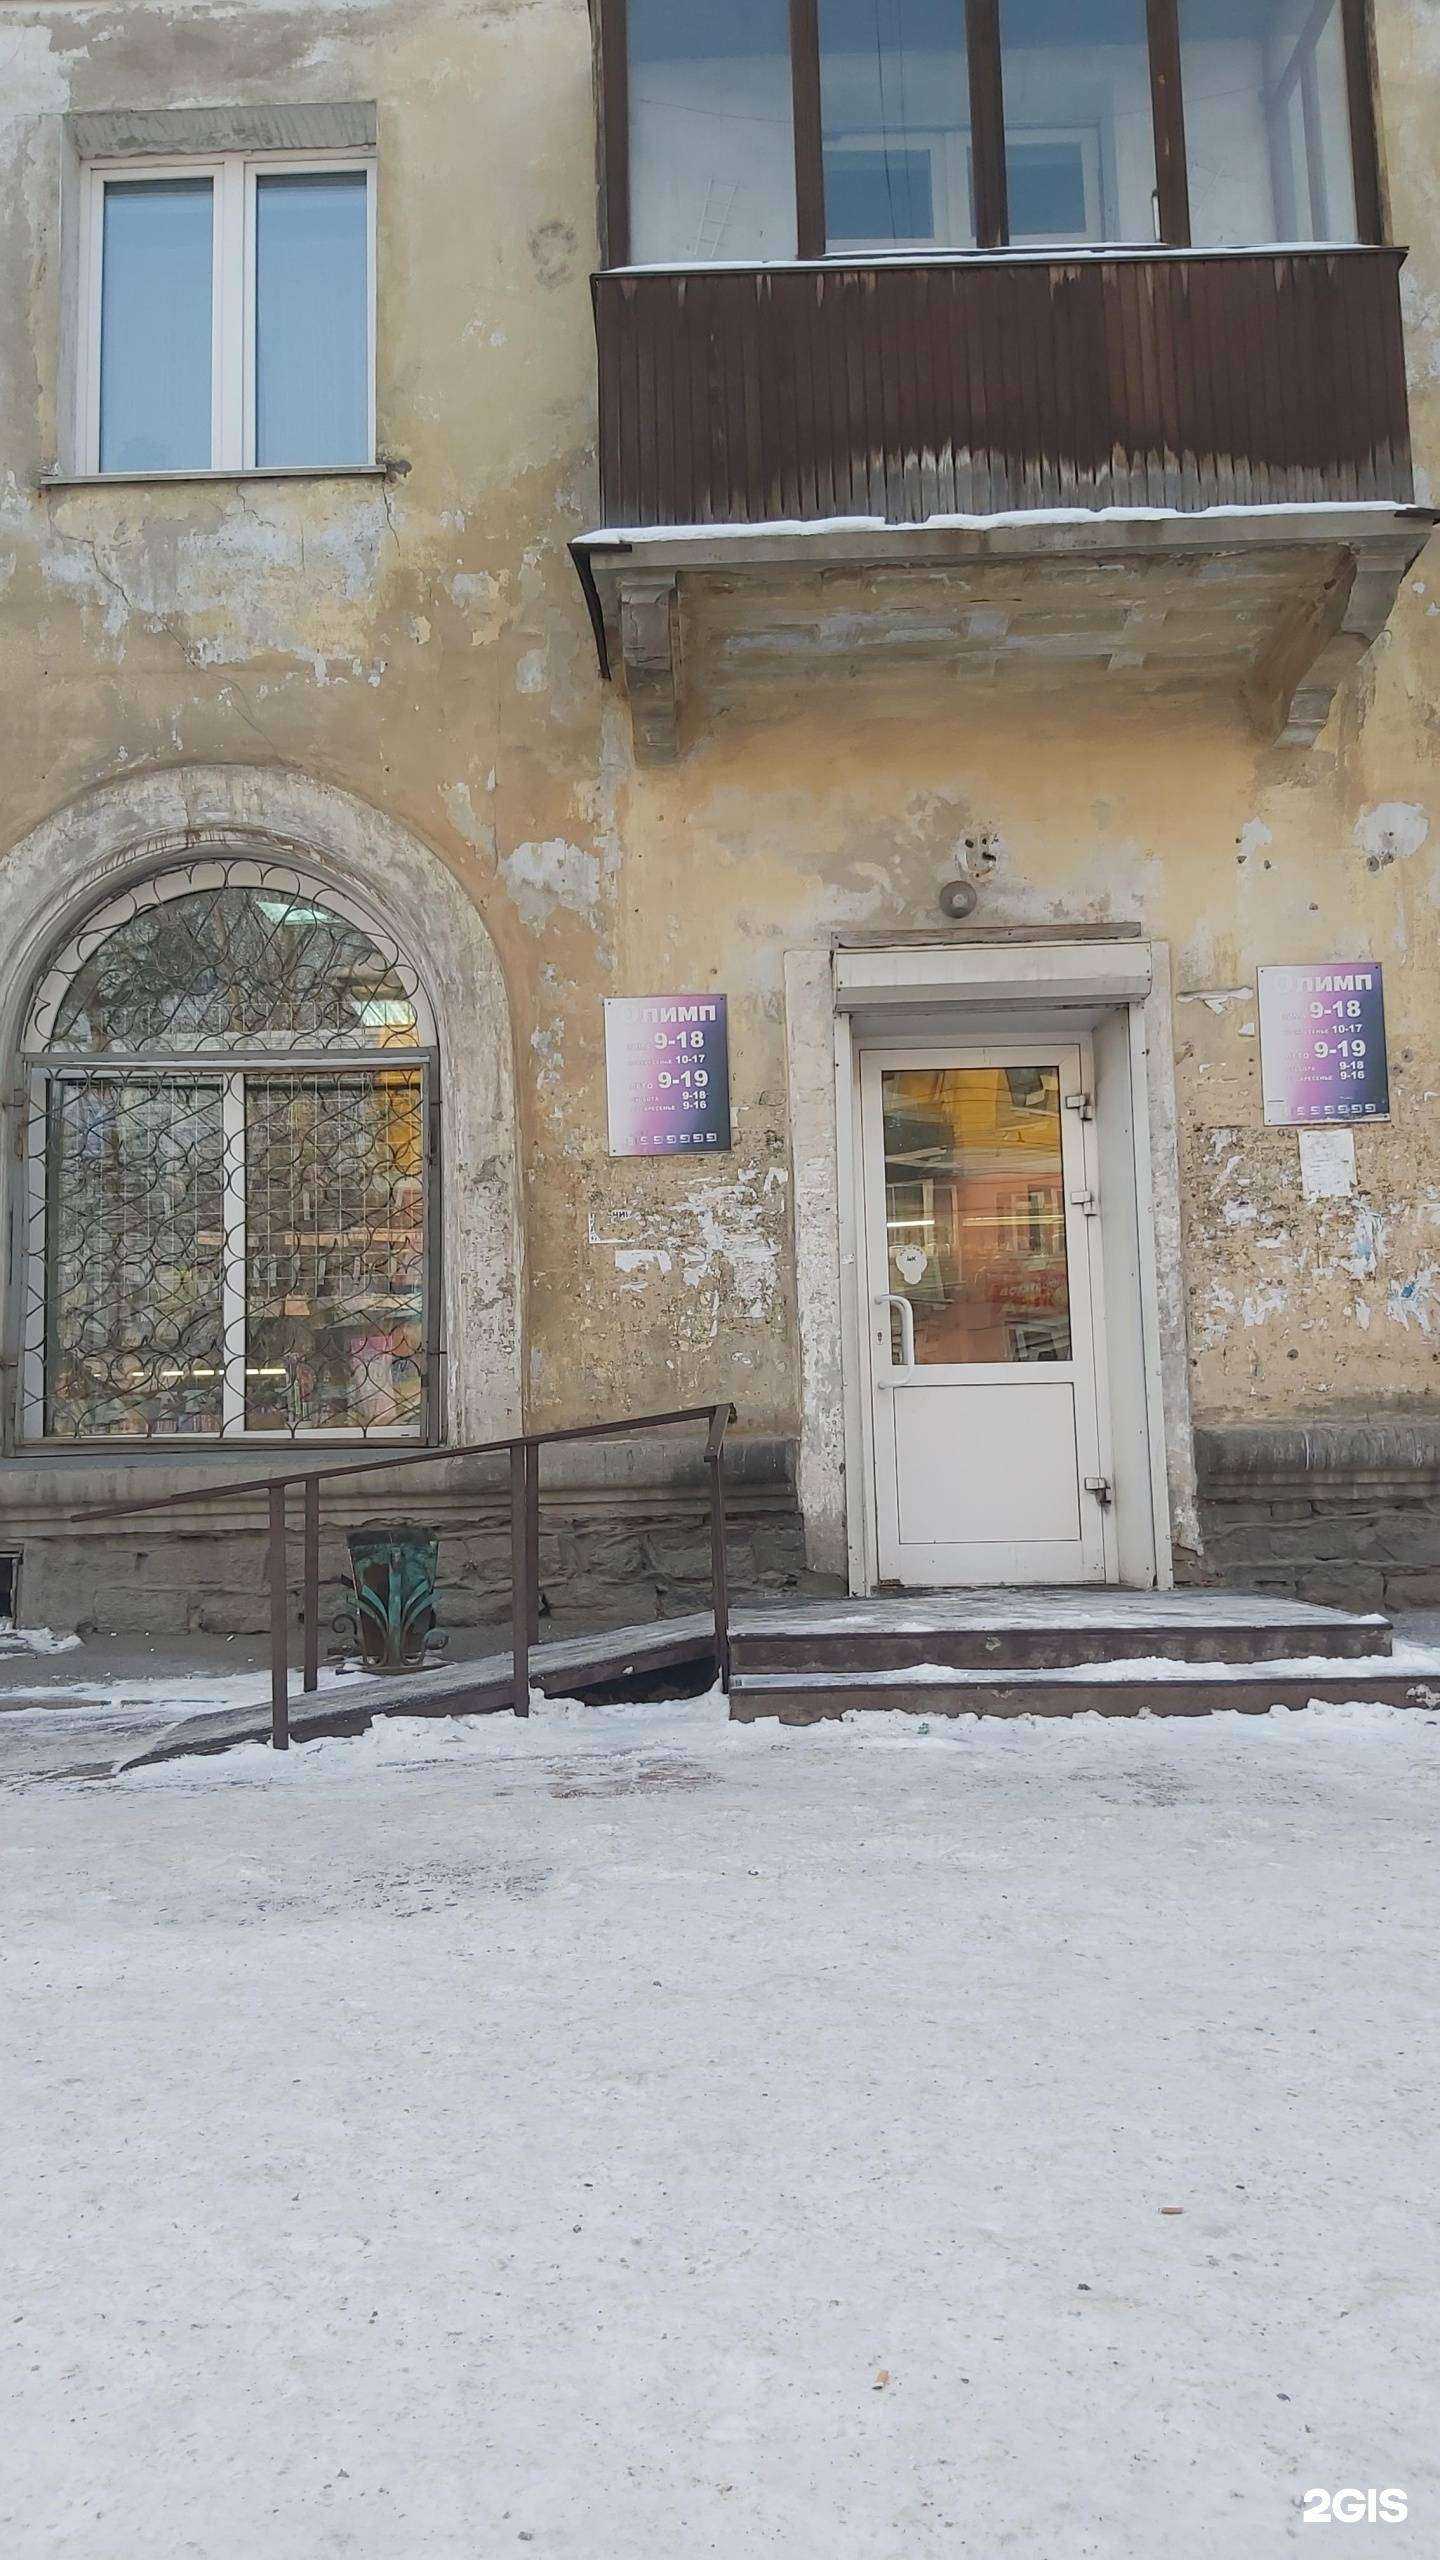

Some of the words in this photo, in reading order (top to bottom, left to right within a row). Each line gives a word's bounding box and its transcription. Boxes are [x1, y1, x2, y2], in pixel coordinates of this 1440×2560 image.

[1274, 974, 1372, 993] ОЛИМП
[624, 1005, 716, 1023] ОЛИМП
[1310, 999, 1361, 1019] 9-18
[1332, 1023, 1363, 1034] 10-17
[654, 1031, 704, 1049] 9-18
[1314, 1039, 1366, 1058] 9-19
[675, 1054, 706, 1065] 10-17
[1339, 1061, 1364, 1070] 9-18
[658, 1069, 708, 1089] 9-19
[1340, 1070, 1365, 1080] 9-16
[682, 1091, 707, 1100] 9-18
[683, 1100, 707, 1110] 9-16
